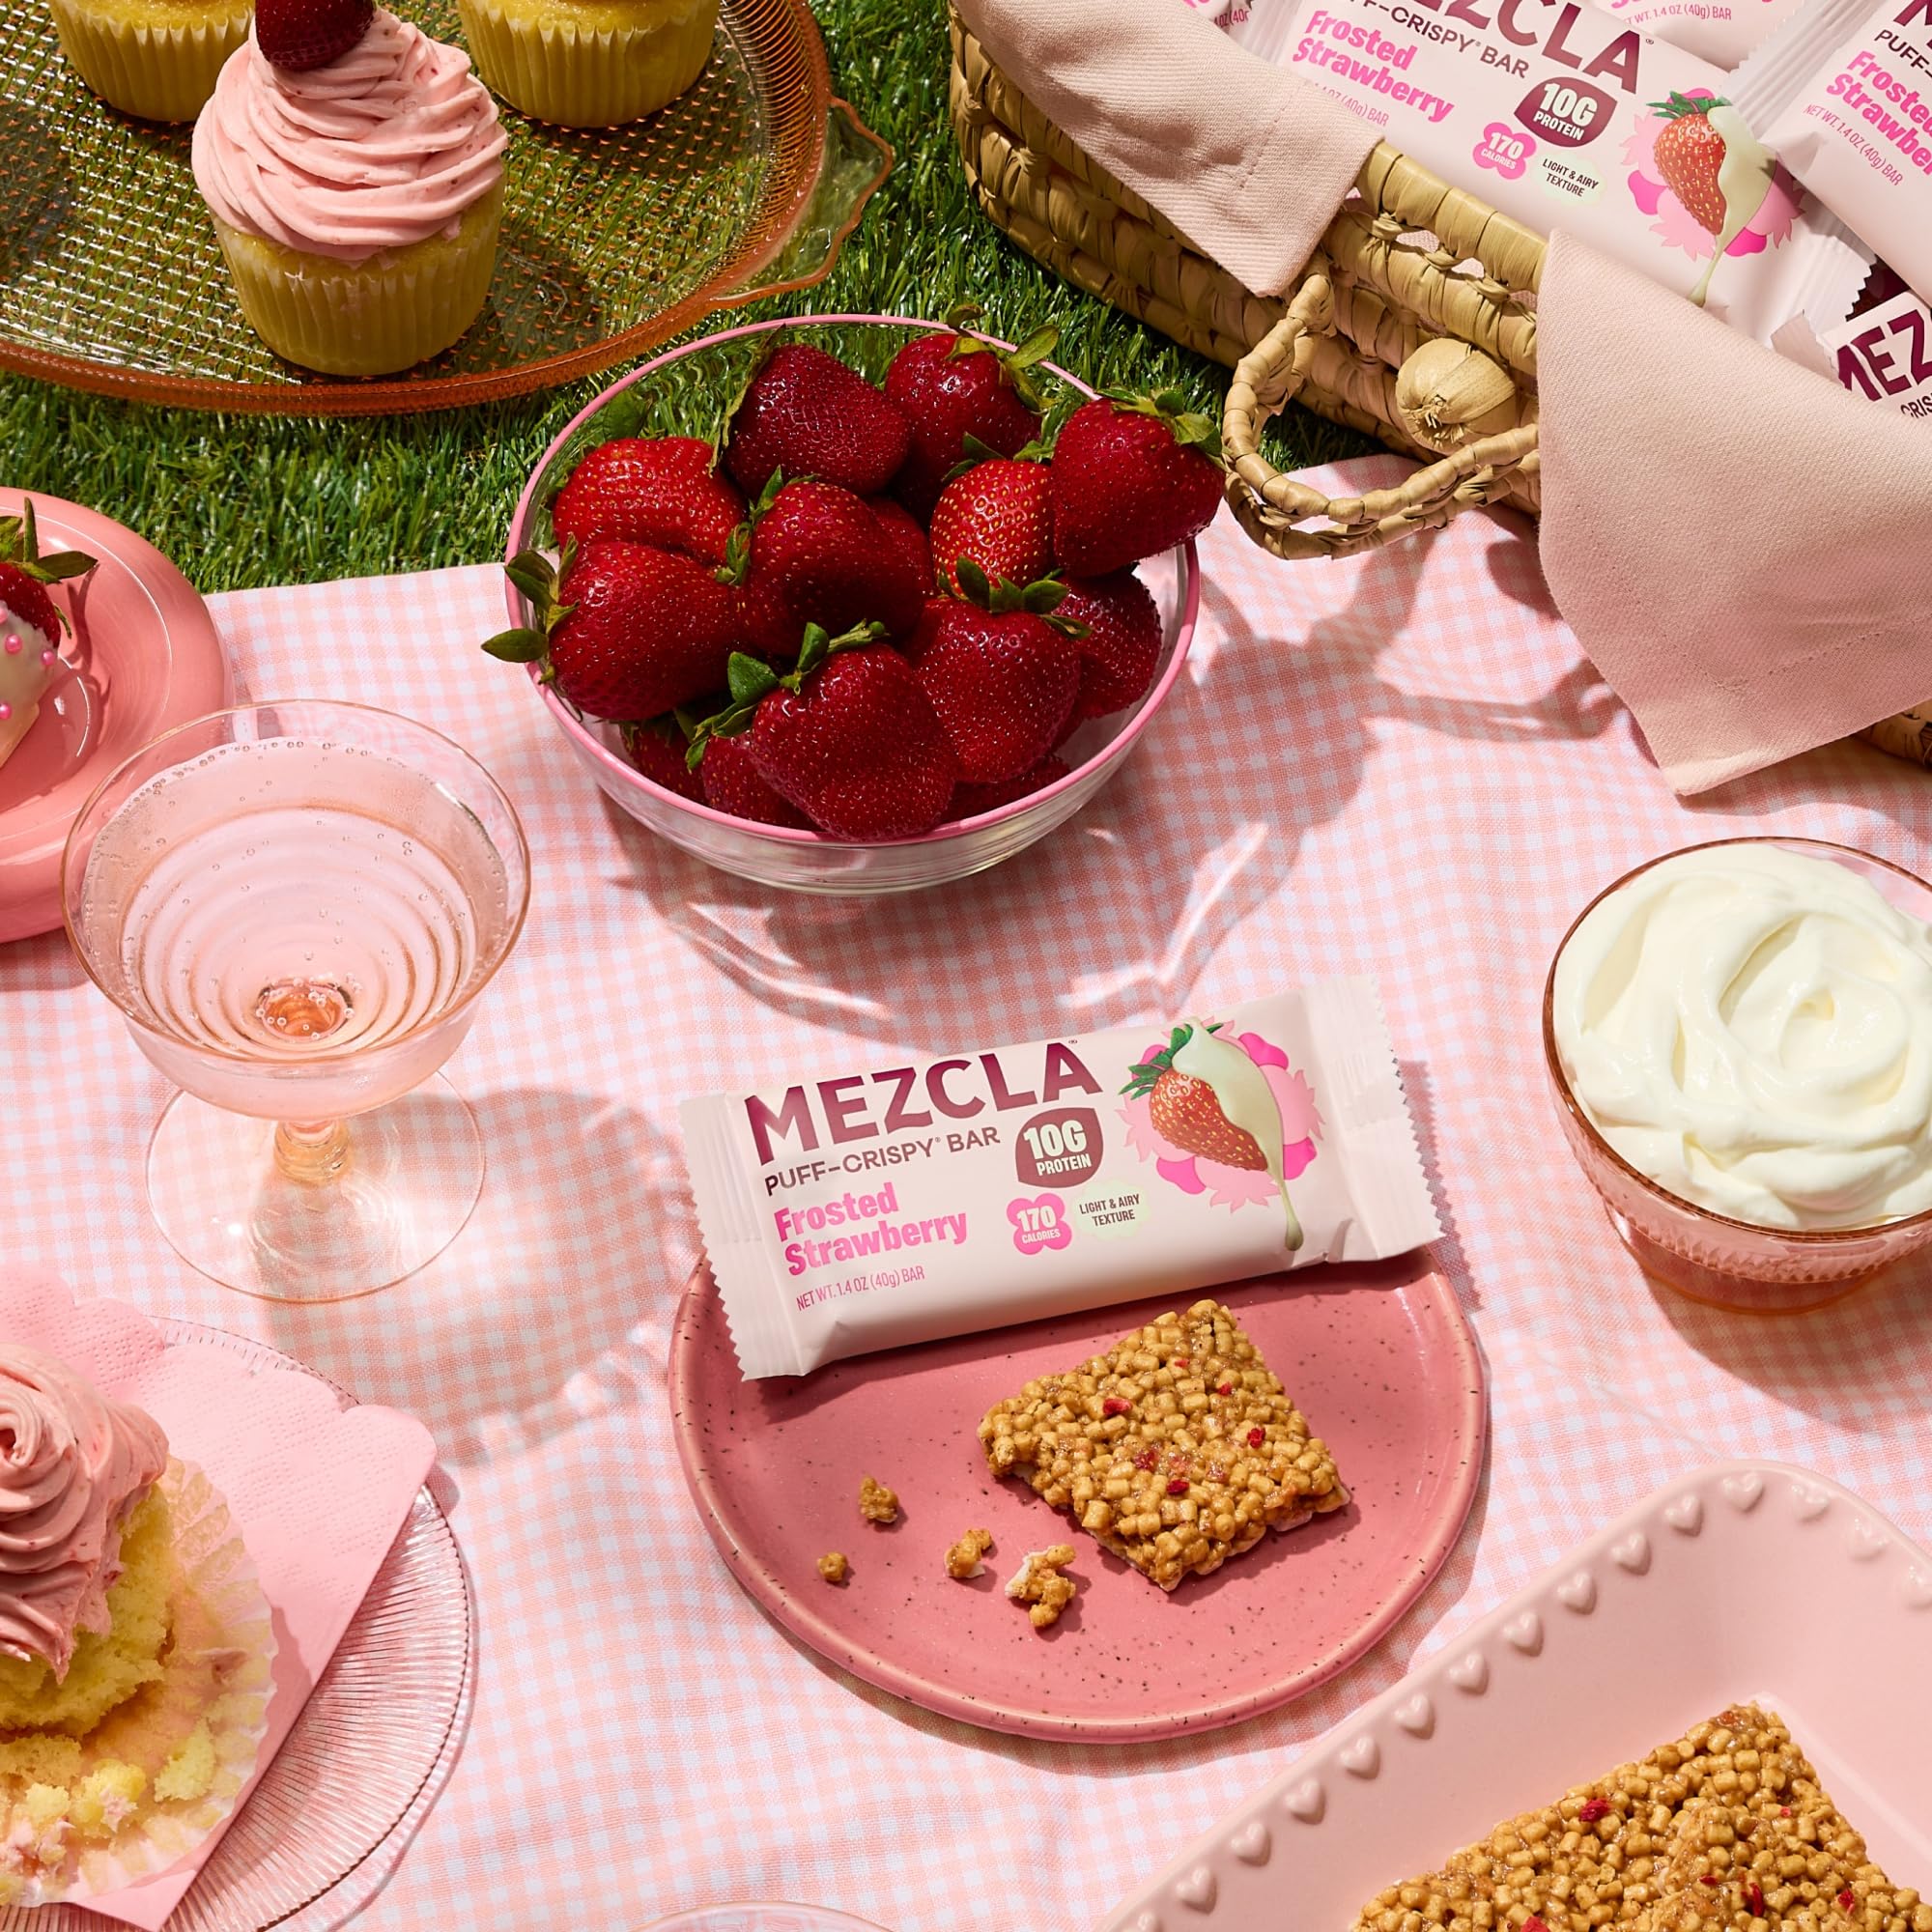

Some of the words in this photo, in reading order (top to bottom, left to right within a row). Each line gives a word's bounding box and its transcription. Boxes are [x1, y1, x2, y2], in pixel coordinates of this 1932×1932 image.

[1669, 5, 1683, 15] OZ
[1684, 5, 1710, 20] (40g)
[1712, 7, 1732, 20] BAR
[1305, 10, 1418, 71] Frosted
[1480, 45, 1529, 78] BAR
[1293, 38, 1455, 123] Strawberry
[1368, 107, 1390, 127] BAR
[1539, 83, 1598, 127] 10G
[1533, 112, 1585, 140] PROTEIN
[1489, 132, 1524, 159] 170
[1803, 104, 1826, 117] NET
[1822, 110, 1840, 128] WT.
[1837, 122, 1853, 137] 1.4
[1849, 132, 1865, 149] OZ
[1860, 143, 1887, 169] (40g)
[1882, 163, 1903, 186] BAR
[1481, 148, 1517, 170] CALORIES
[1543, 158, 1569, 177] LIGHT
[1569, 169, 1577, 180] &
[1577, 173, 1599, 189] AIRY
[1546, 173, 1585, 197] TEXTURE
[1900, 393, 1932, 418] CRIS
[947, 1126, 1001, 1152] BAR
[1023, 1120, 1087, 1159] 10G
[1036, 1153, 1092, 1177] PROTEIN
[774, 1181, 898, 1242] Frosted
[1079, 1200, 1107, 1214] LIGHT
[1109, 1198, 1117, 1208] &
[1118, 1193, 1140, 1208] AIRY
[1016, 1206, 1057, 1233] 170
[1092, 1209, 1136, 1227] TEXTURE
[785, 1212, 967, 1276] Strawberry
[1021, 1228, 1061, 1244] CALORIES
[796, 1291, 815, 1311] NET
[814, 1284, 837, 1302] WT.
[837, 1279, 852, 1295] 1.4
[853, 1276, 868, 1292] OZ
[869, 1268, 900, 1290] (40g)
[901, 1265, 925, 1283] BAR
